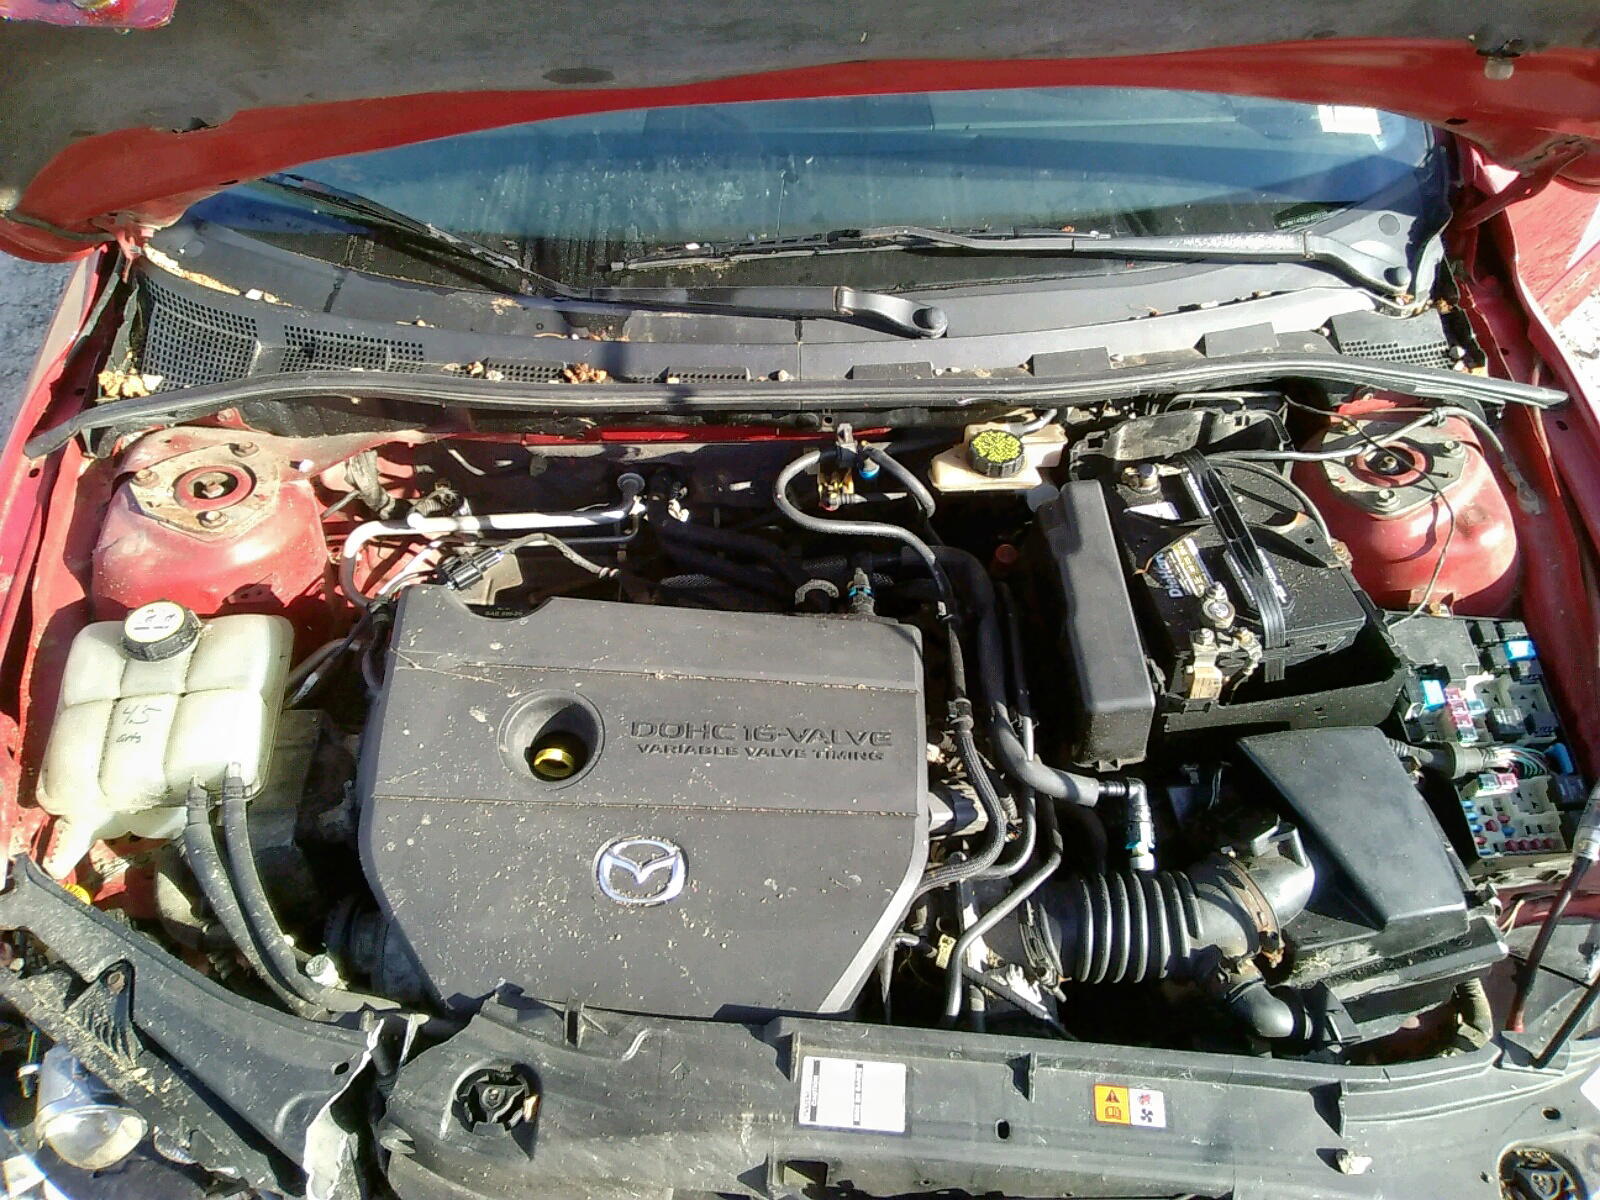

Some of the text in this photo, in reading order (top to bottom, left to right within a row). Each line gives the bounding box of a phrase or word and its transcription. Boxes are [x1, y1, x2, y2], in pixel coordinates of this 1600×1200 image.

[630, 721, 893, 747] DOHC 16-VALVE
[636, 743, 884, 761] VARIABLE VALVE TIMING
